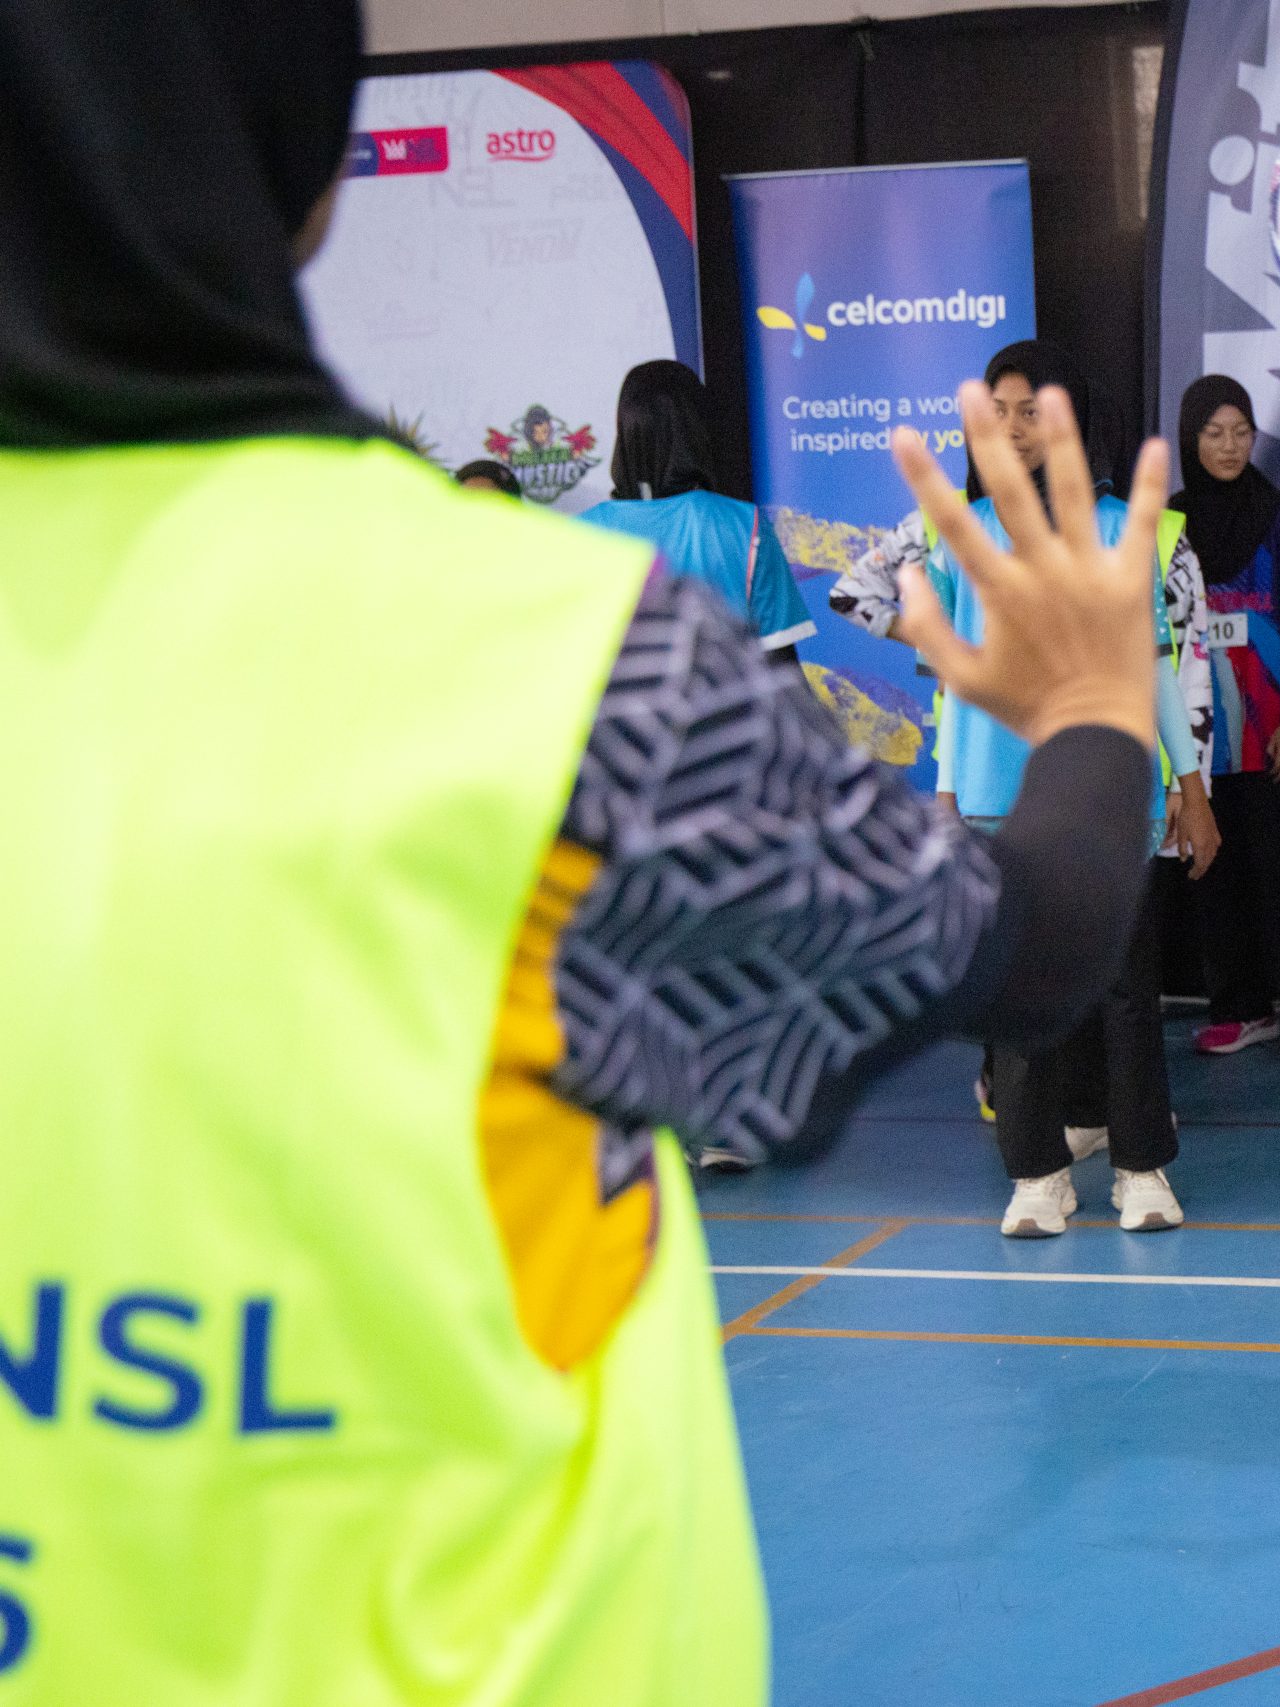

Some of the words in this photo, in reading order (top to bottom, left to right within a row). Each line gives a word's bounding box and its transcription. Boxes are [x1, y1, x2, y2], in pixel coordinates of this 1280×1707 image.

[486, 129, 556, 155] astro
[827, 288, 1006, 328] celcomdigi
[782, 394, 890, 422] Creating
[897, 400, 912, 416] a
[917, 396, 960, 416] wo
[790, 426, 892, 455] inspired
[1212, 621, 1235, 640] 10
